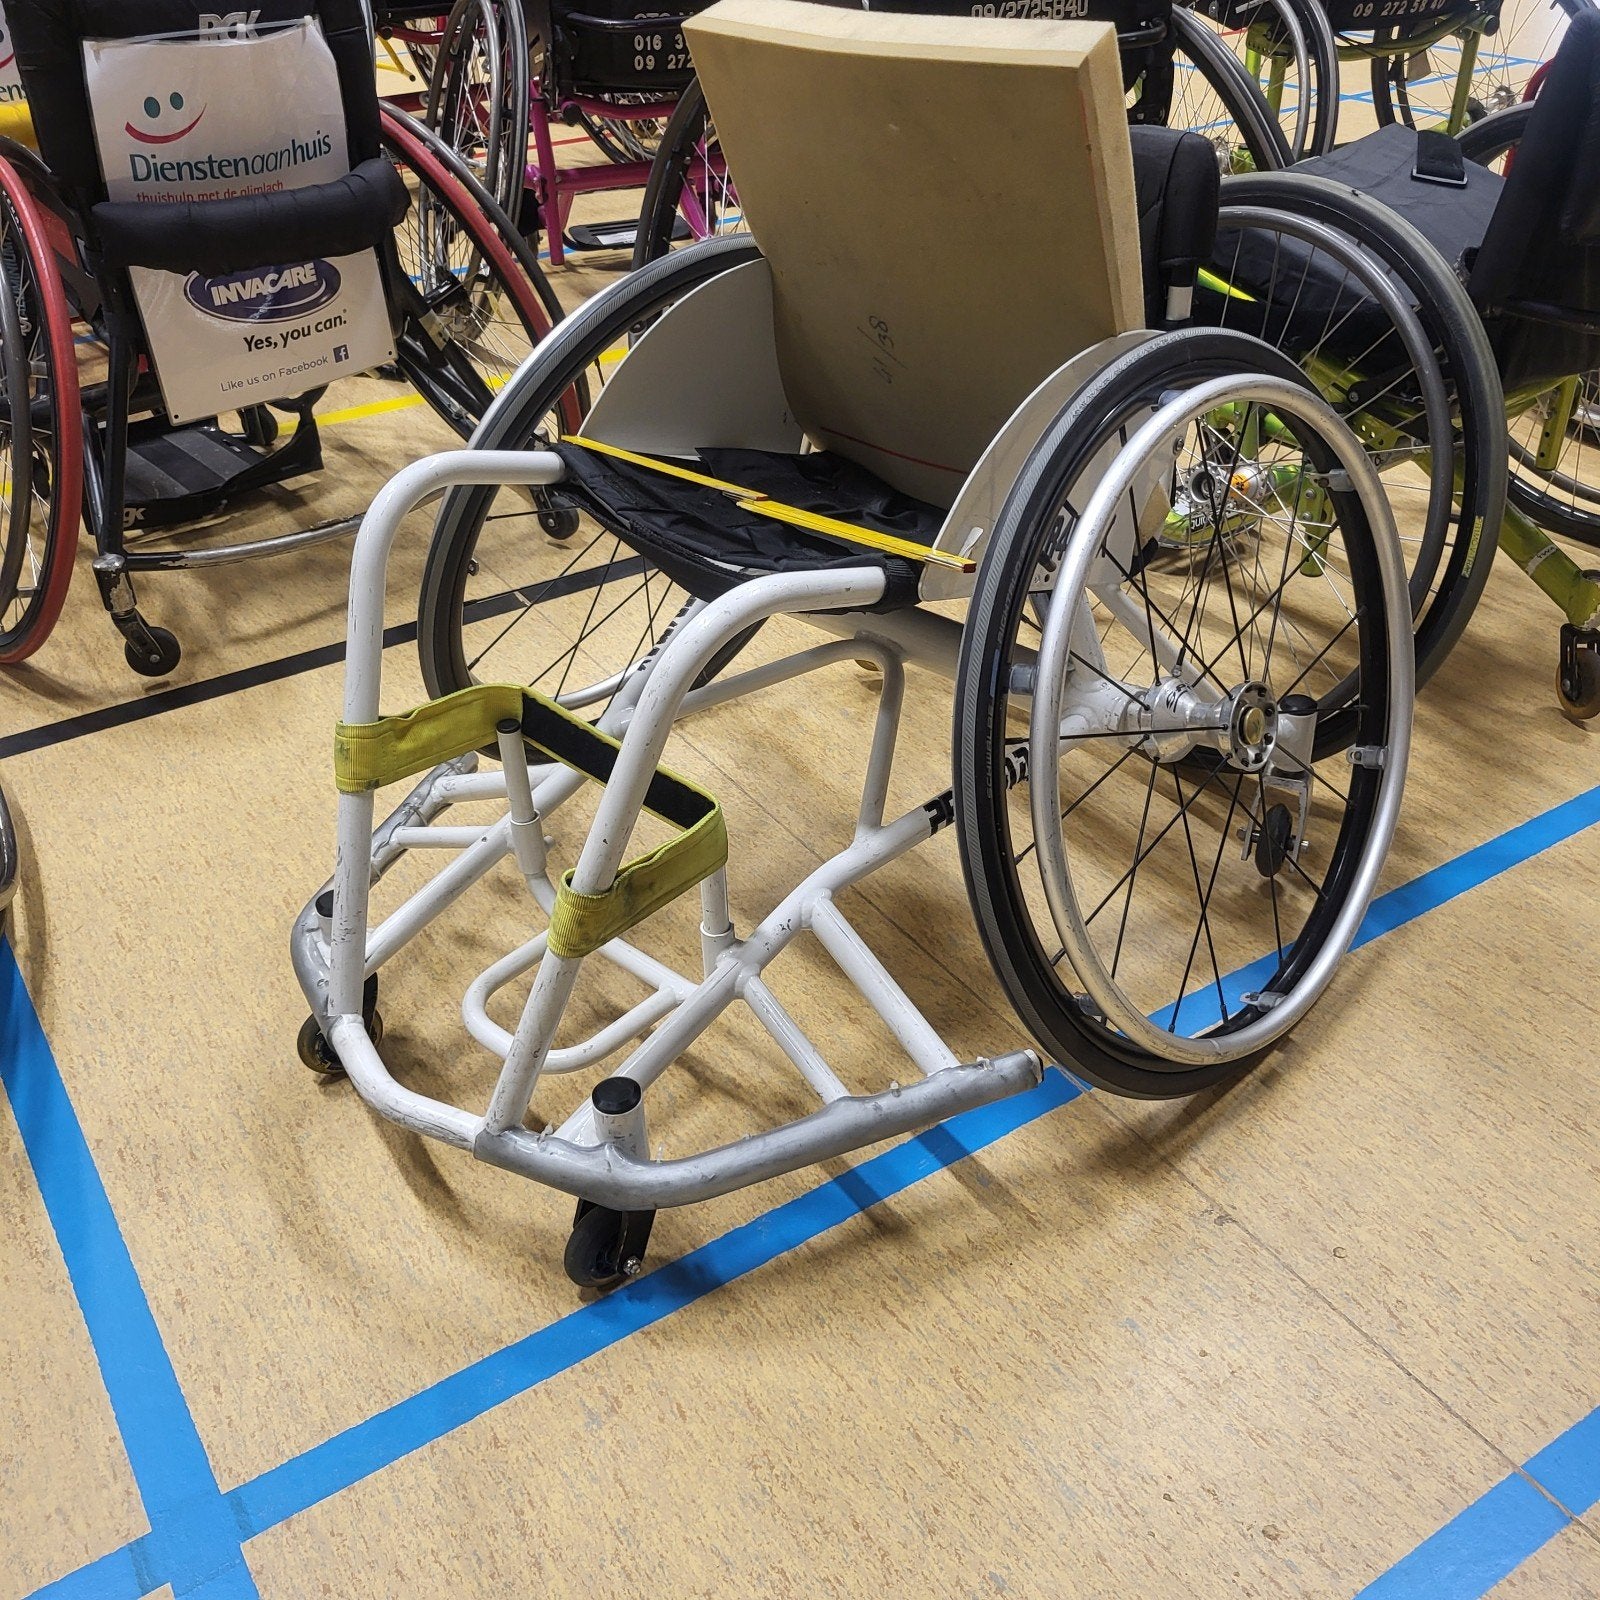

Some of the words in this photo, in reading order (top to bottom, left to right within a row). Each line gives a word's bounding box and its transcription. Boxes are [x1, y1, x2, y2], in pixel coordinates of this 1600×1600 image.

[1353, 3, 1374, 17] 09
[634, 35, 662, 51] 016
[634, 55, 655, 71] 09
[129, 130, 332, 182] Dienstenaanhuis
[197, 190, 220, 202] met
[223, 188, 237, 199] de
[210, 262, 317, 306] INVACARE
[243, 335, 278, 352] Yes,
[279, 326, 311, 348] you
[220, 381, 244, 392] Like
[247, 376, 260, 386] us
[262, 371, 277, 382] on
[278, 356, 328, 377] Facebook
